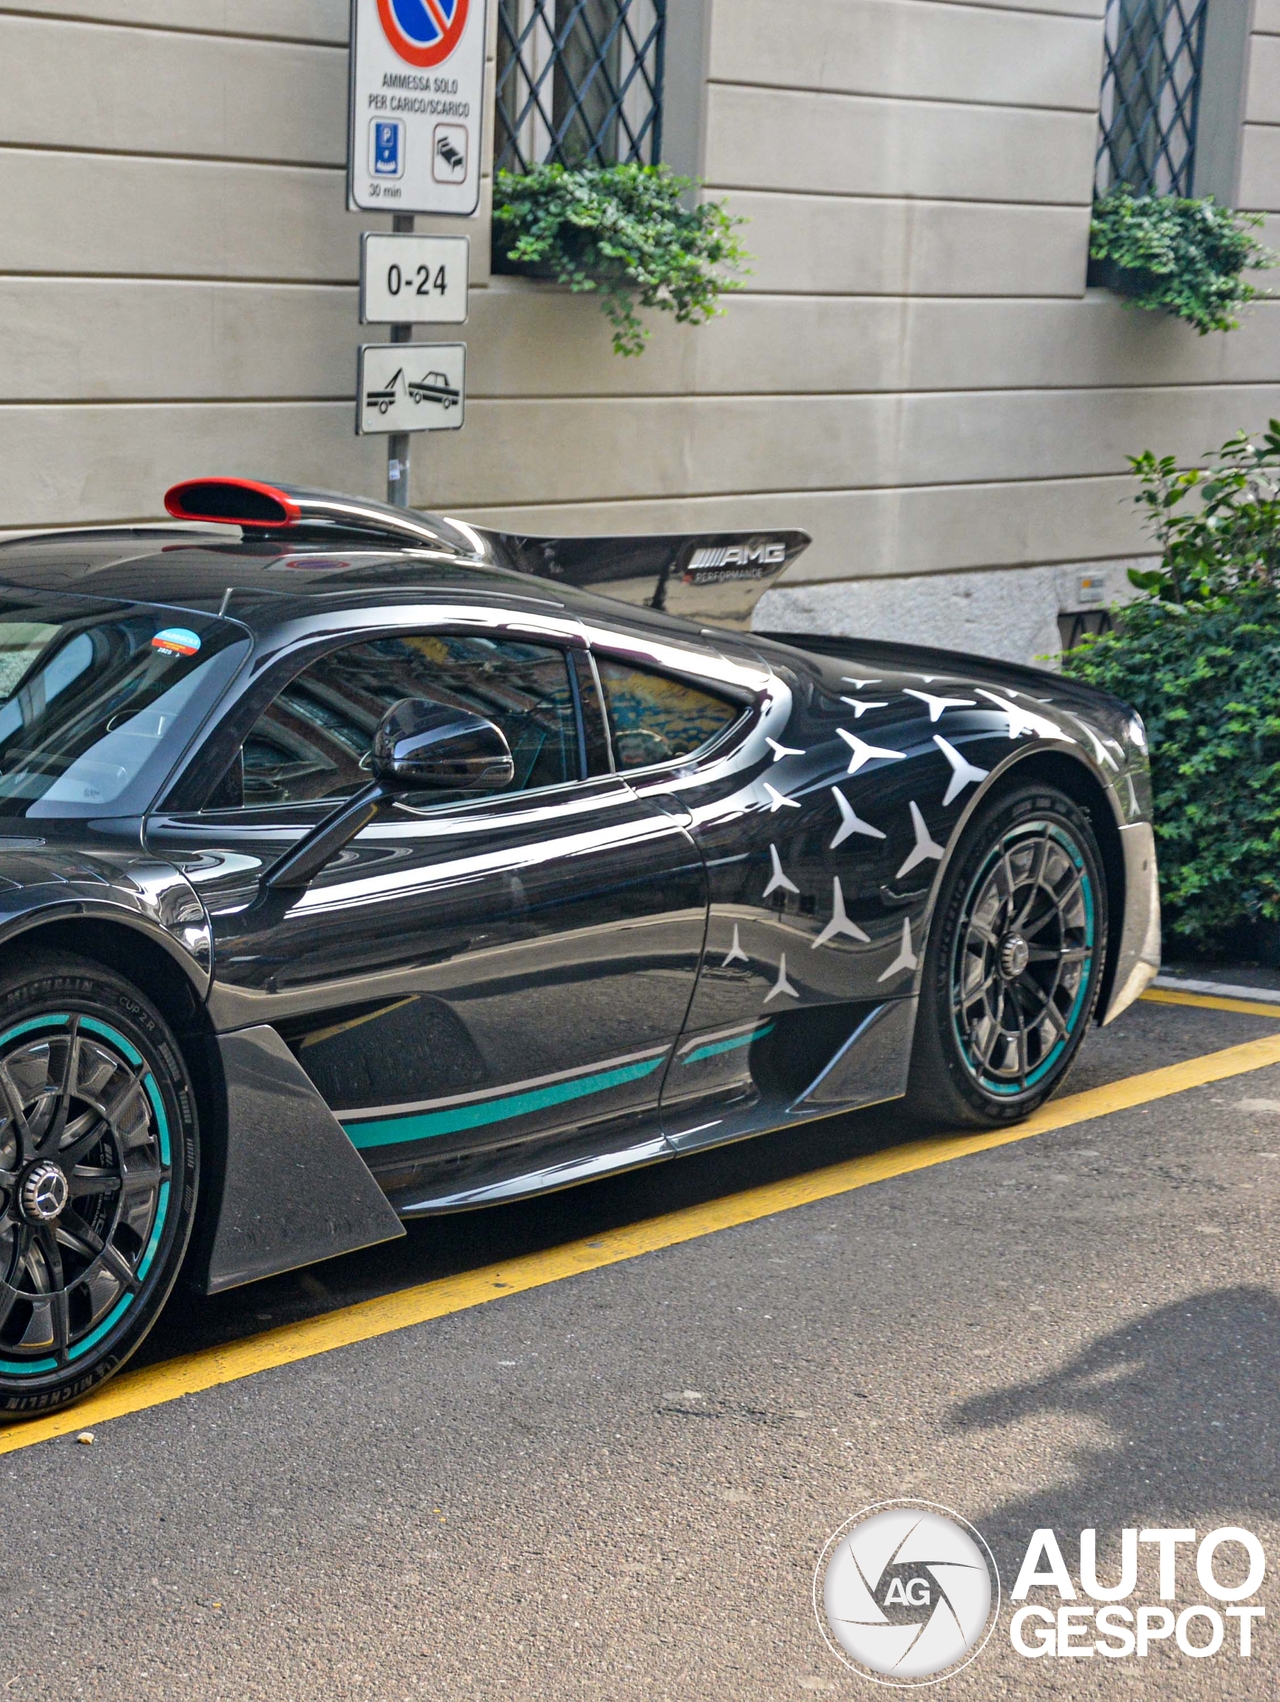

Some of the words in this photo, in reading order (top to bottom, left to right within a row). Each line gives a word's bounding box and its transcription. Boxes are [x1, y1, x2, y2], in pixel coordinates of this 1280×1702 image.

[382, 72, 431, 92] AMMESSA
[434, 77, 458, 95] SOLO
[368, 94, 388, 111] PER
[390, 96, 470, 118] CARICO/SCARICO
[369, 183, 381, 198] 30
[383, 184, 401, 198] min
[387, 264, 447, 296] 0-24
[721, 542, 786, 567] AMG
[120, 996, 140, 1013] CUP
[139, 1012, 147, 1023] 2
[146, 1020, 156, 1031] R
[5, 1373, 93, 1409] MICHELIN
